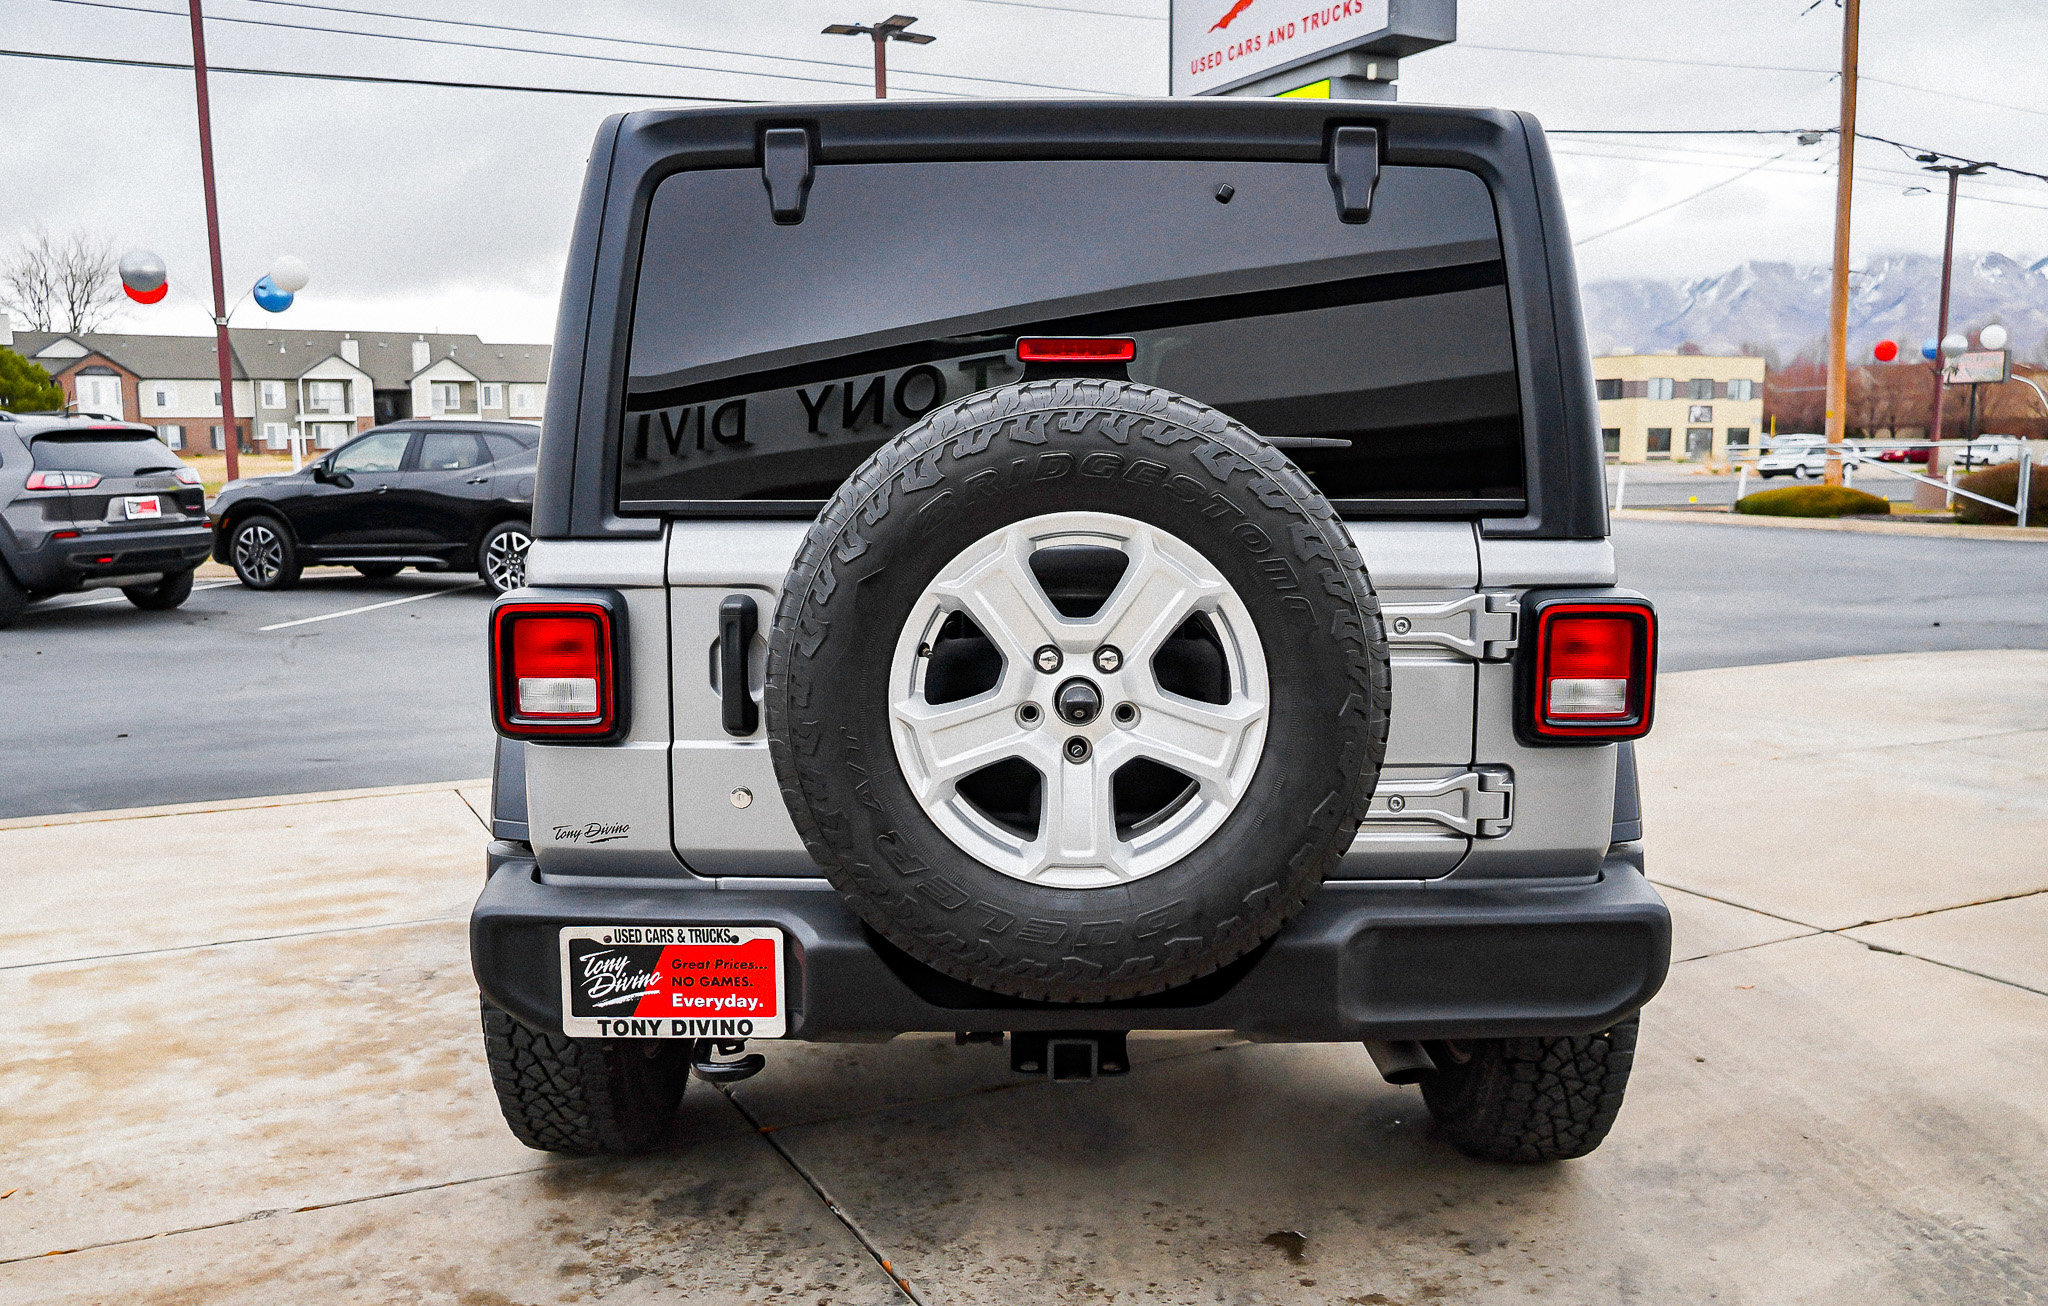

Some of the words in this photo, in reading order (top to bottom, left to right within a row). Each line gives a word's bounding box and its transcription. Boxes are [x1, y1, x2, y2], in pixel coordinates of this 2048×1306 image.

[1190, 50, 1222, 75] USED
[1227, 35, 1262, 62] CARS
[1267, 22, 1296, 48] AND
[1302, 0, 1363, 34] TRUCKS
[553, 824, 582, 843] Tony
[583, 822, 631, 838] Divino
[613, 928, 642, 943] USED
[645, 928, 675, 943] CARS
[677, 929, 686, 943] &
[688, 928, 731, 944] TRUCKS
[579, 949, 630, 978] Tony
[671, 959, 711, 970] Great
[715, 958, 768, 971] Prices...
[580, 969, 664, 999] Divino
[671, 977, 695, 987] NO
[699, 976, 754, 988] GAMES.
[672, 993, 764, 1011] Everyday.
[597, 1019, 663, 1036] TONY
[671, 1019, 754, 1037] DIVINO
